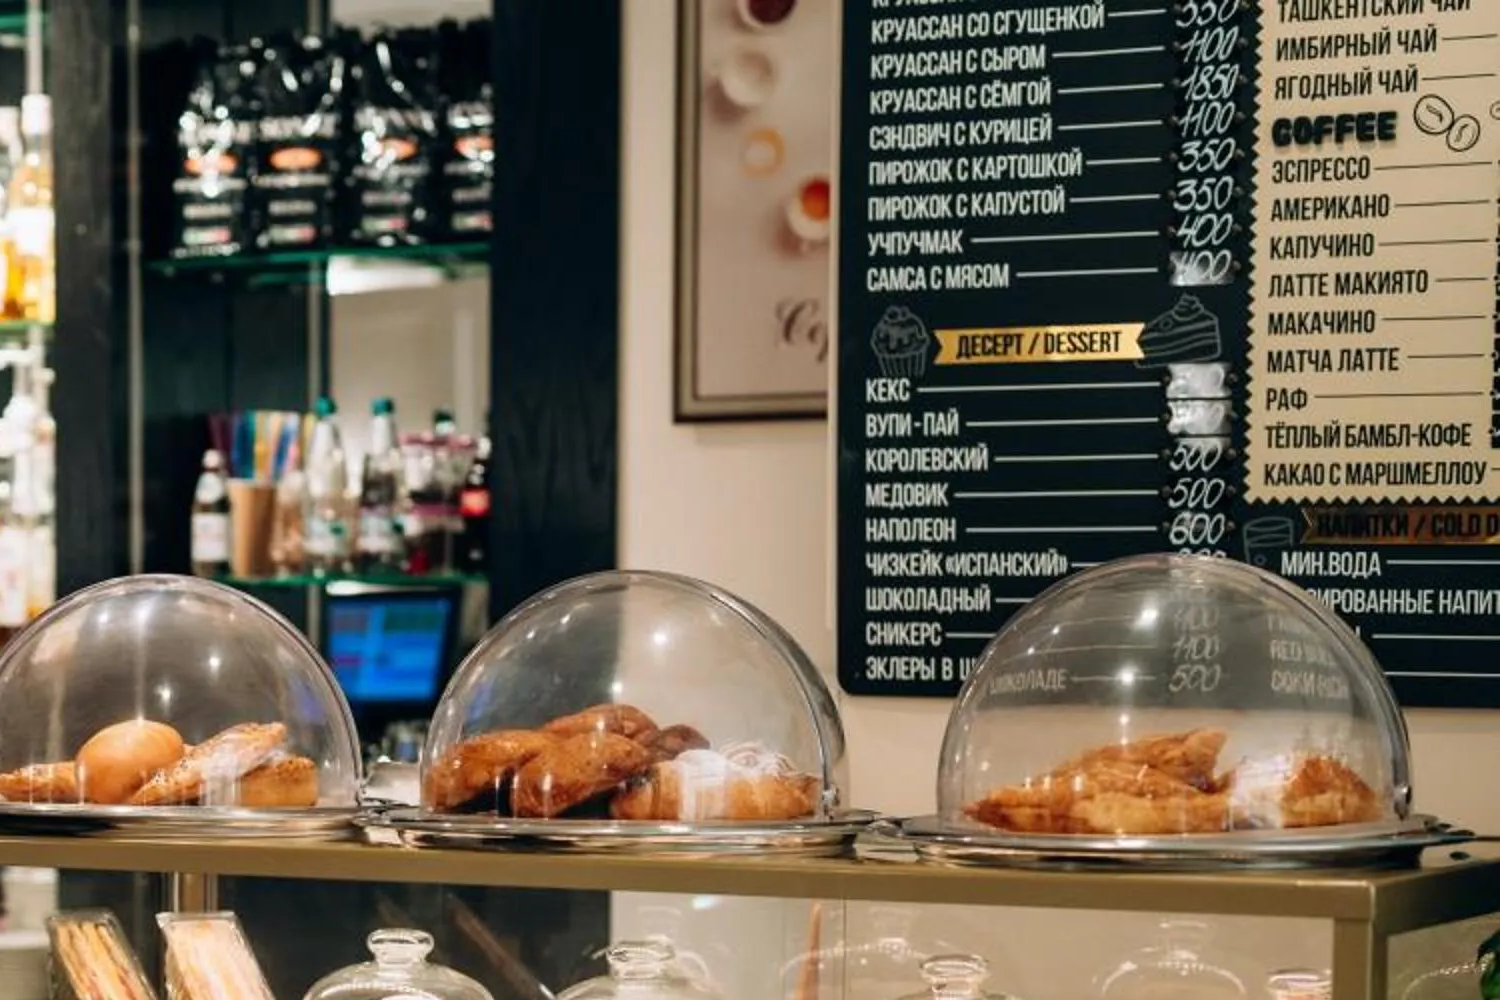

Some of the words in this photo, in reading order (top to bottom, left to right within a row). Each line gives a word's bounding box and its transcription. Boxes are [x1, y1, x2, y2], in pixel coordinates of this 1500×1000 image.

[871, 14, 963, 44] КРУАССАН
[967, 11, 990, 37] СО
[993, 0, 1104, 36] СГУЩЕНКОЙ
[1180, 26, 1239, 62] 1100
[1276, 27, 1391, 61] ИМБИРНЫЙ
[1397, 24, 1438, 54] ЧАЙ
[870, 50, 962, 79] КРУАССАН
[965, 49, 978, 73] С
[981, 44, 1047, 72] СЫРОМ
[870, 86, 961, 115] КРУАССАН
[964, 84, 977, 109] С
[980, 77, 1052, 108] СЁМГОЙ
[1181, 63, 1240, 100] 1850
[1275, 67, 1373, 100] ЯГОДНЫЙ
[1378, 64, 1419, 93] ЧАЙ
[869, 122, 951, 151] СЭНДВИЧ
[954, 121, 967, 145] С
[969, 113, 1053, 145] КУРИЦЕЙ
[1179, 101, 1235, 137] 1100
[1272, 111, 1398, 147] COFFEE
[868, 158, 953, 185] ПИРОЖОК
[957, 157, 969, 182] С
[972, 147, 1083, 180] КАРТОШКОЙ
[1178, 138, 1236, 172] 350
[1272, 156, 1370, 183] ЭСПРЕССО
[868, 194, 953, 221] ПИРОЖОК
[956, 193, 968, 218] С
[971, 184, 1065, 217] КАПУСТОЙ
[1173, 175, 1234, 211] 350
[1270, 193, 1390, 222] АМЕРИКАНО
[868, 229, 964, 256] УЧПУЧМАК
[1176, 213, 1233, 248] 400
[1269, 233, 1375, 260] КАПУЧИНО
[867, 266, 927, 292] САМСА
[930, 265, 942, 290] С
[945, 263, 1009, 289] МЯСОМ
[1268, 272, 1329, 297] ЛАТТЕ
[1335, 269, 1429, 296] МАКИЯТО
[1268, 309, 1375, 335] МАКАЧИНО
[956, 333, 1024, 360] ДЕСЕРТ
[1044, 330, 1123, 355] DESSERT
[1267, 348, 1332, 373] МАТЧА
[1338, 347, 1400, 372] ЛАТТЕ
[866, 378, 911, 403] КЕКС
[1266, 387, 1308, 412] РАФ
[1265, 419, 1341, 449] ТЁПЛЫЙ
[1345, 422, 1473, 448] БАМБЛ-КОФЕ
[866, 442, 989, 473] КОРОЛЕВСКИЙ
[1169, 438, 1222, 472] 500
[1264, 462, 1325, 487] КАКАО
[1329, 462, 1341, 485] С
[1345, 461, 1487, 486] МАРШМЕЛЛОУ
[866, 483, 949, 510] МЕДОВИК
[1168, 478, 1225, 509] 500
[866, 518, 956, 542] НАПОЛЕОН
[1169, 511, 1225, 545] 600
[866, 550, 943, 577] ЧИЗКЕЙК
[866, 584, 991, 615] ШОКОЛАДНЫЙ
[866, 621, 942, 647] СНИКЕРС
[866, 656, 935, 681] ЭКЛЕРЫ
[941, 656, 953, 681] В
